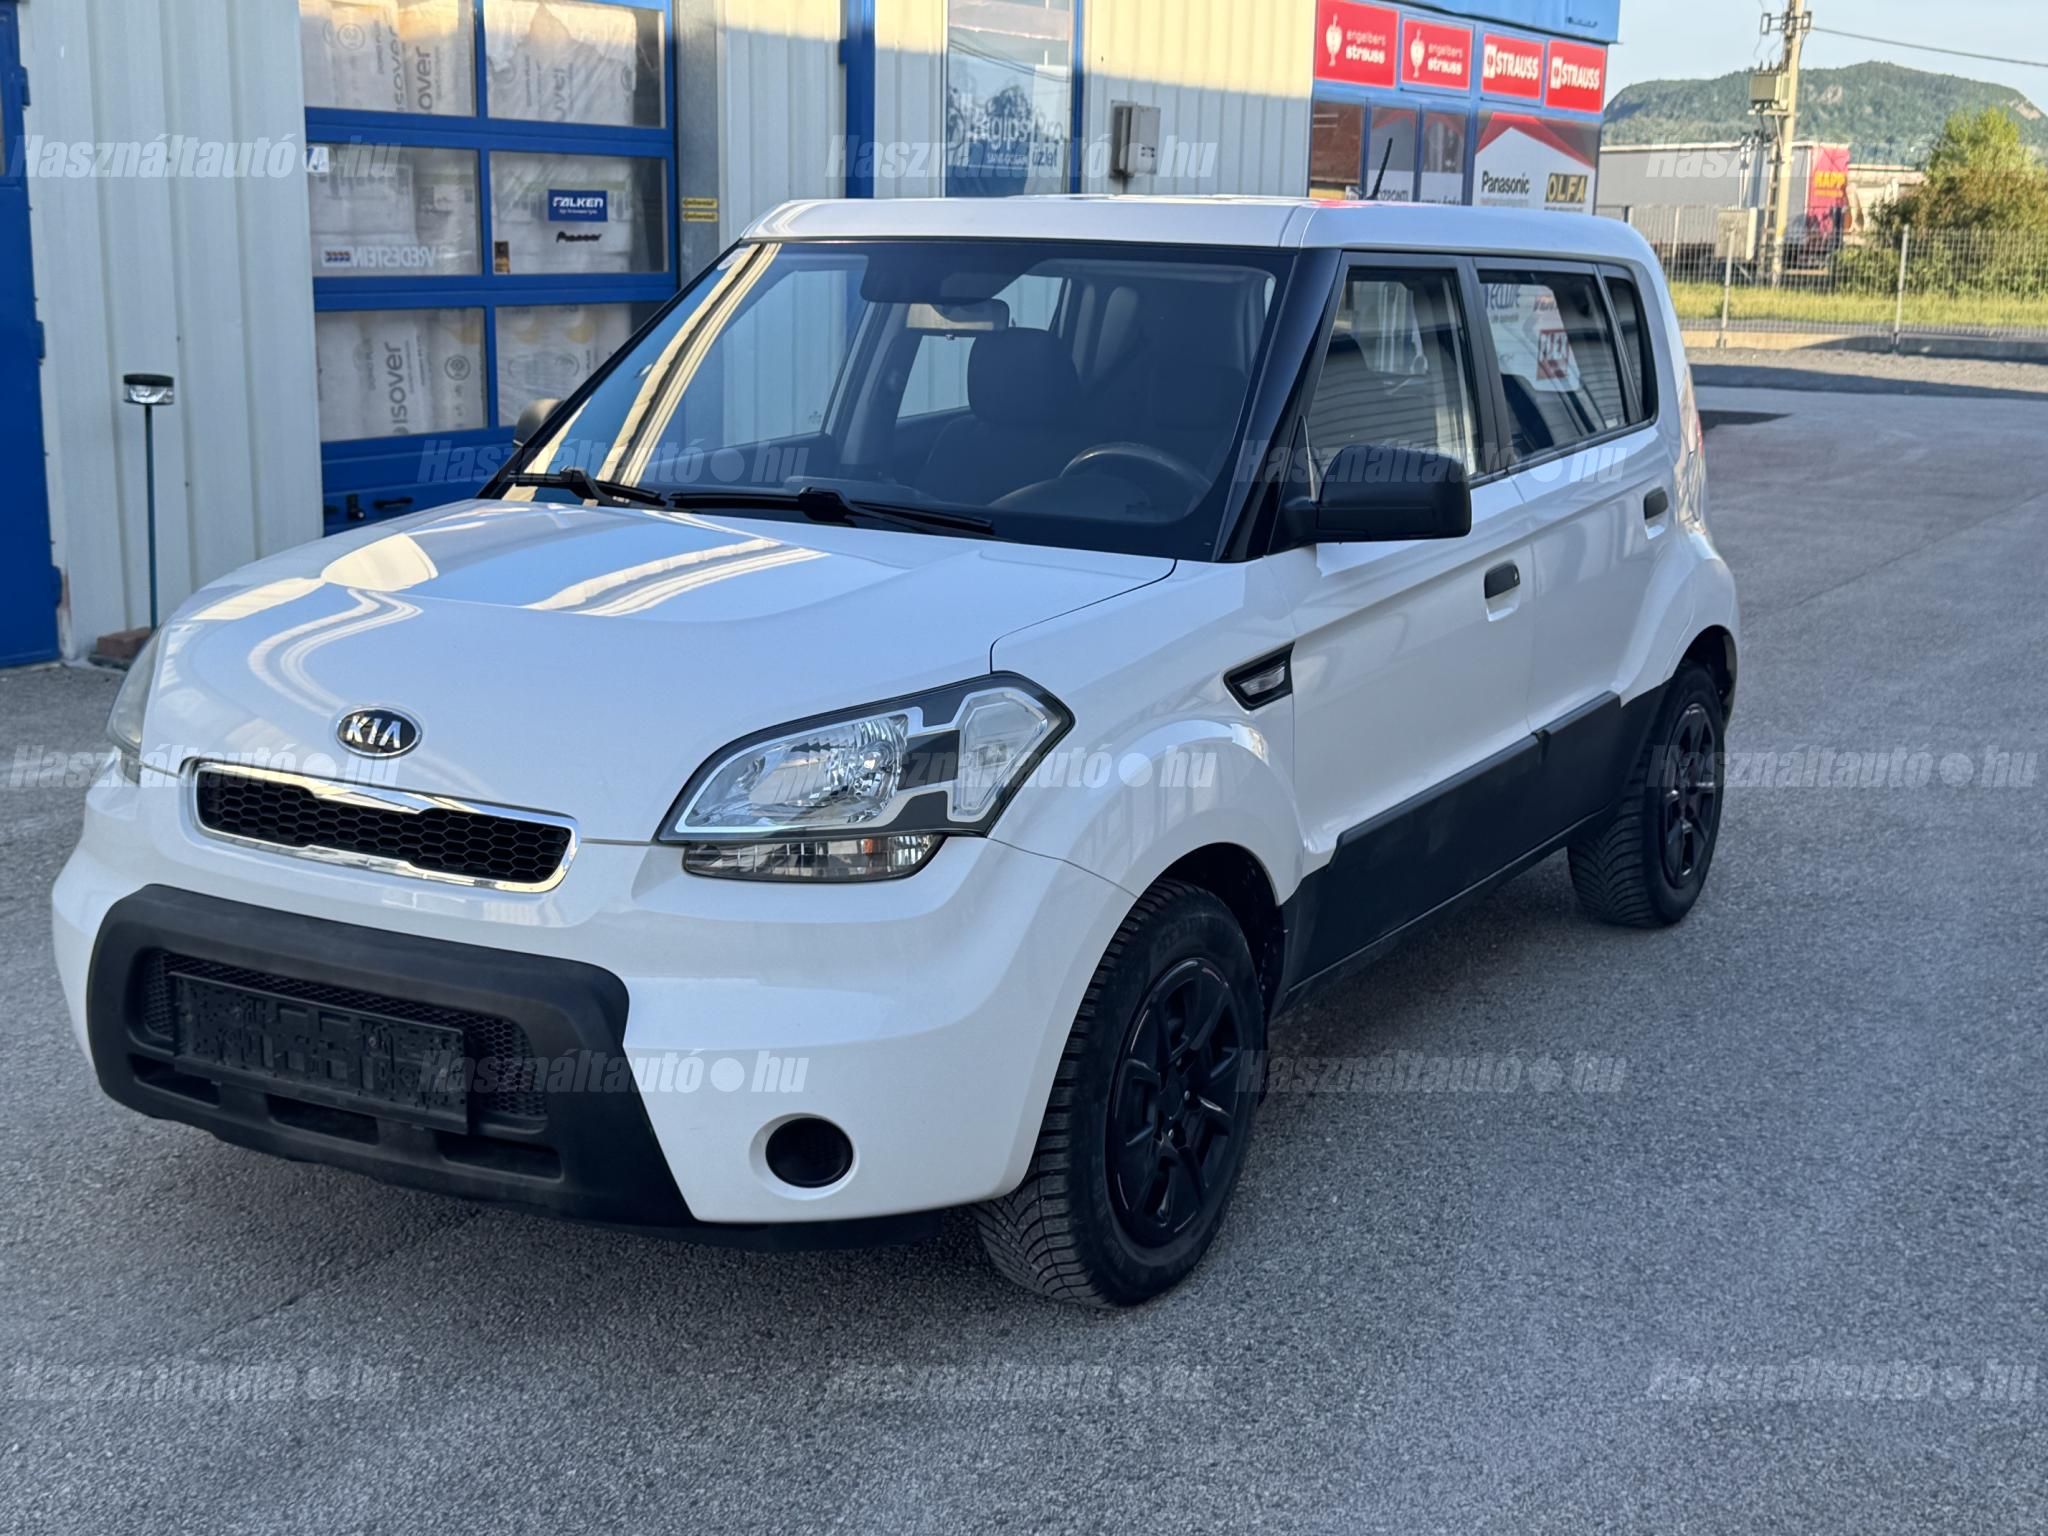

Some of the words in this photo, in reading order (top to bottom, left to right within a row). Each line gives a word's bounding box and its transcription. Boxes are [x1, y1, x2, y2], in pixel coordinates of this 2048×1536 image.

[1345, 45, 1386, 64] strauss
[1427, 57, 1462, 76] strauss
[1496, 51, 1539, 80] STRAUSS
[1561, 63, 1600, 90] STRAUSS
[1481, 170, 1530, 195] Panasonic
[1547, 175, 1587, 202] OLFA
[552, 196, 604, 209] FALKEN
[384, 341, 409, 425] isover
[346, 715, 402, 749] KIA
